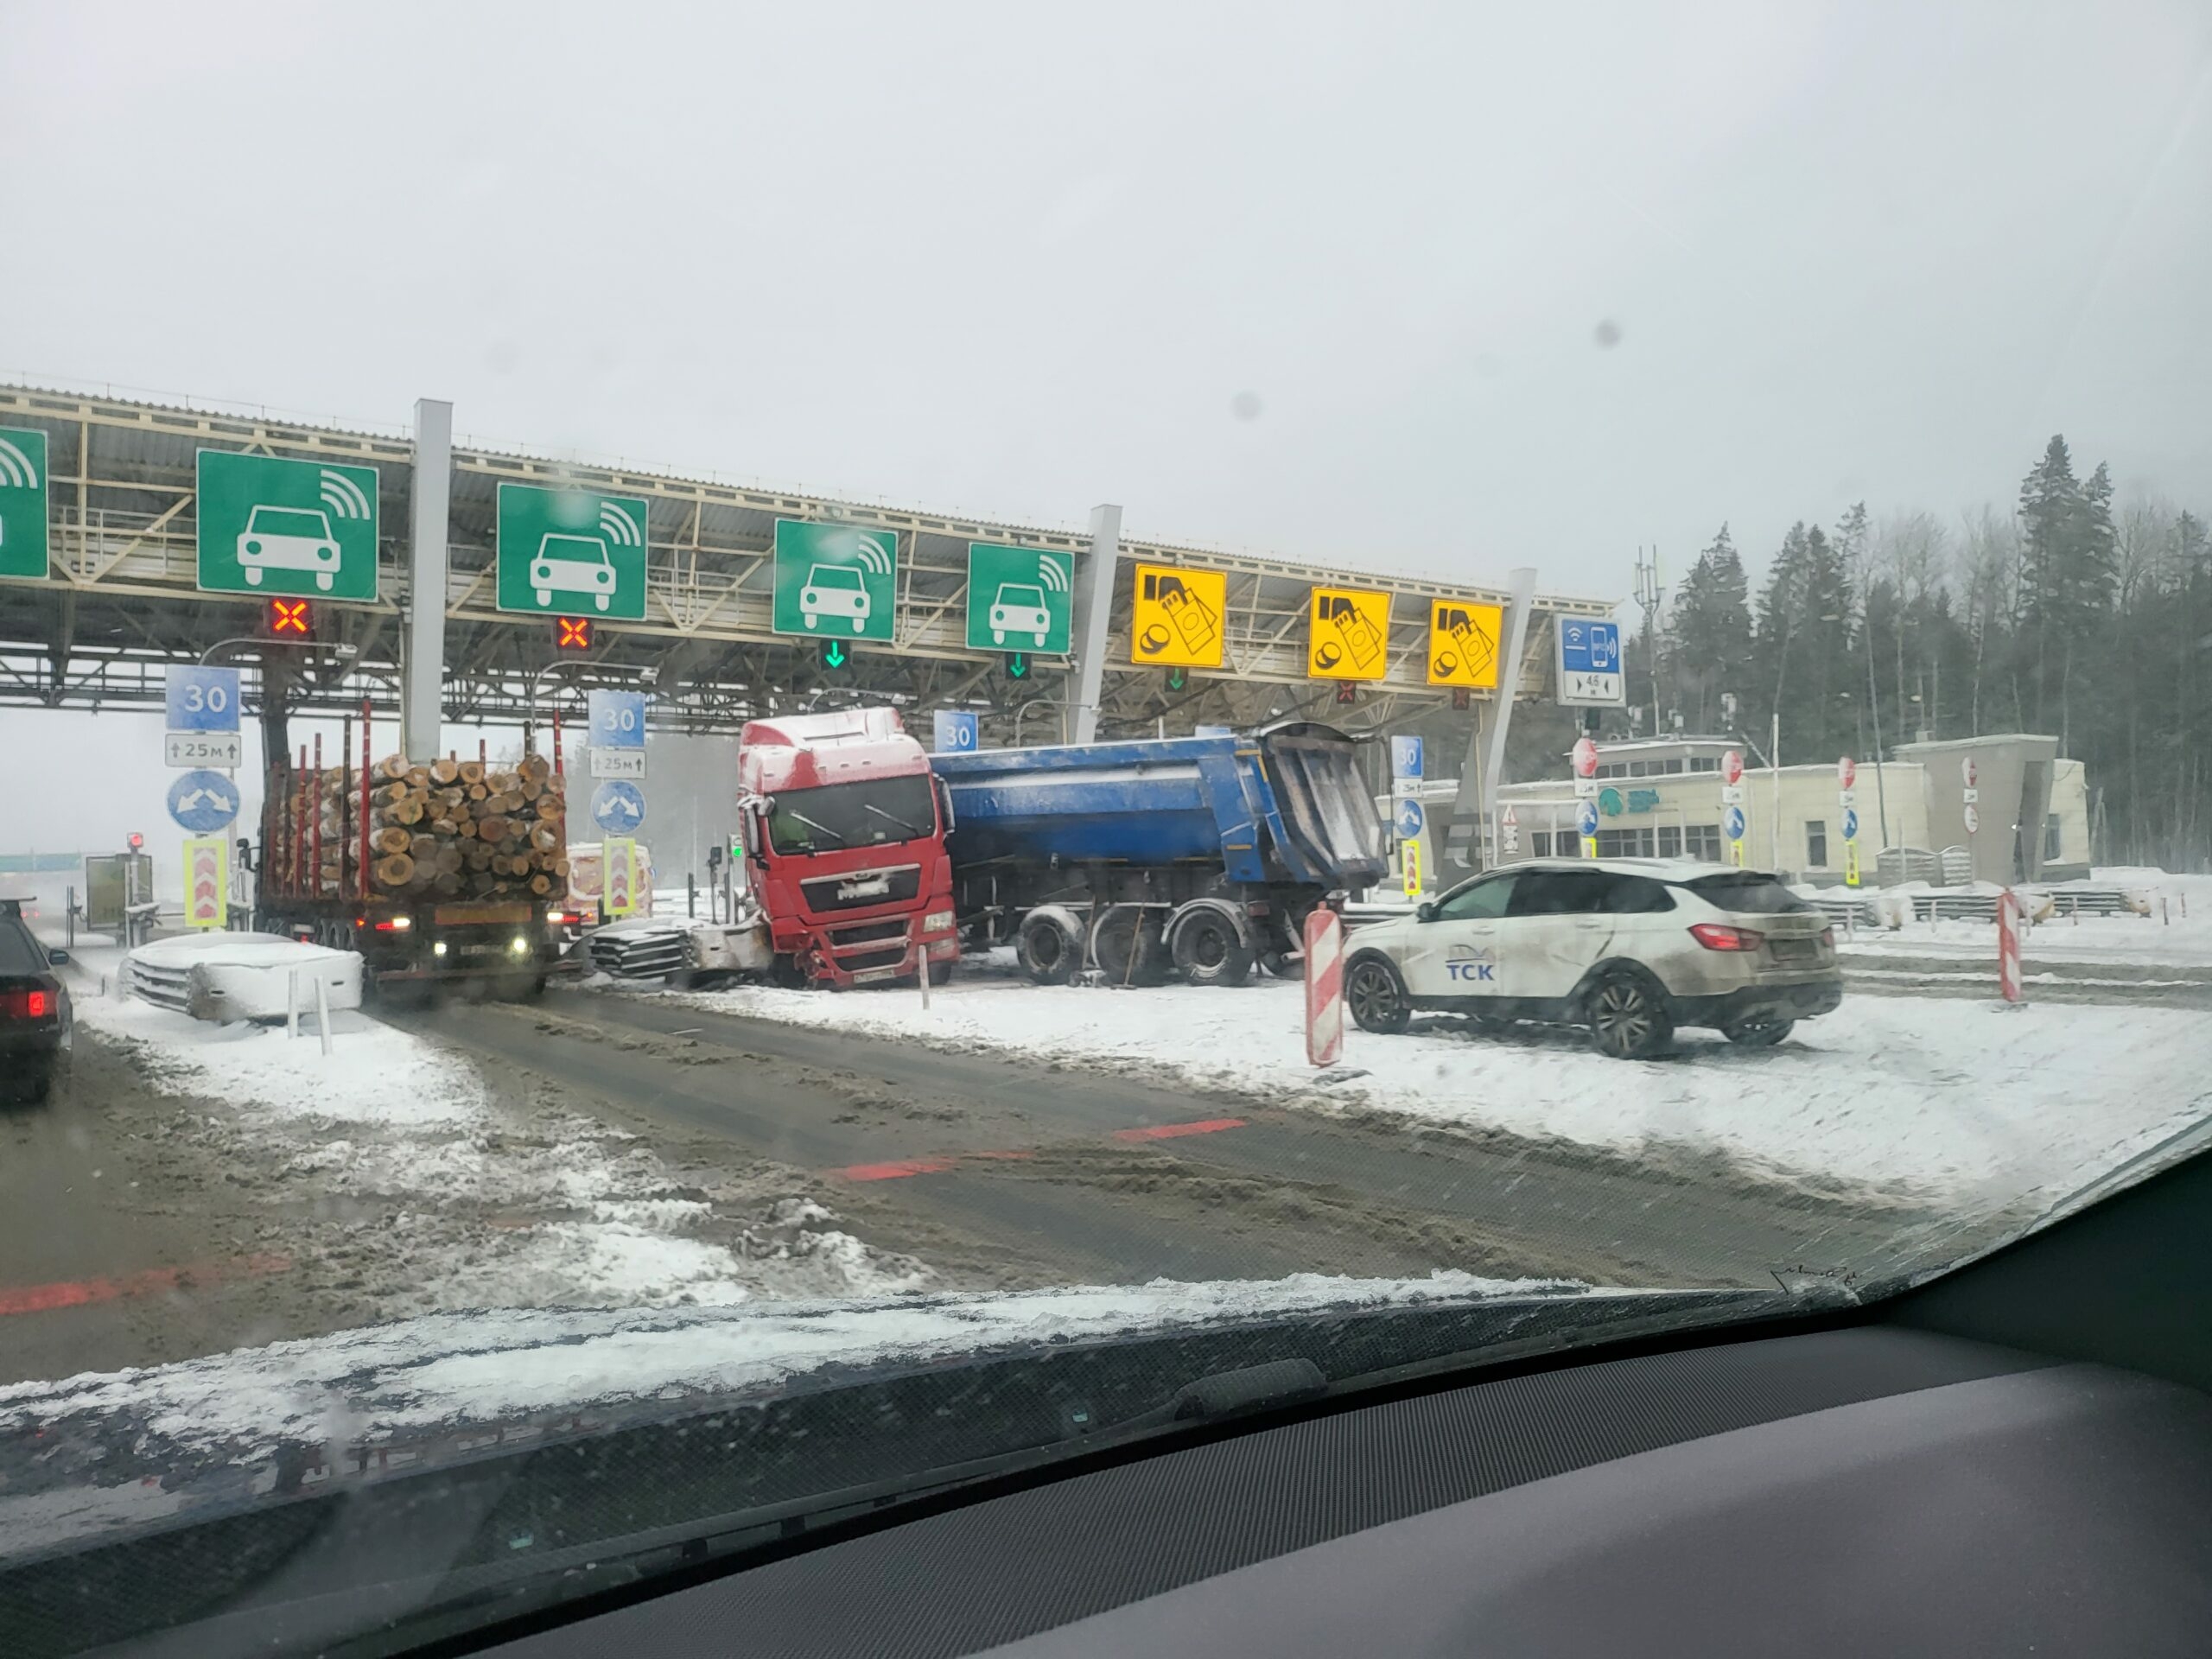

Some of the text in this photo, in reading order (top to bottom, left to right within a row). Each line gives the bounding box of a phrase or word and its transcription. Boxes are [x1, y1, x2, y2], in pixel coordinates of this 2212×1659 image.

[185, 684, 227, 713] 30
[604, 708, 635, 732] 30
[946, 725, 970, 747] 30
[1446, 963, 1496, 982] ТСК
